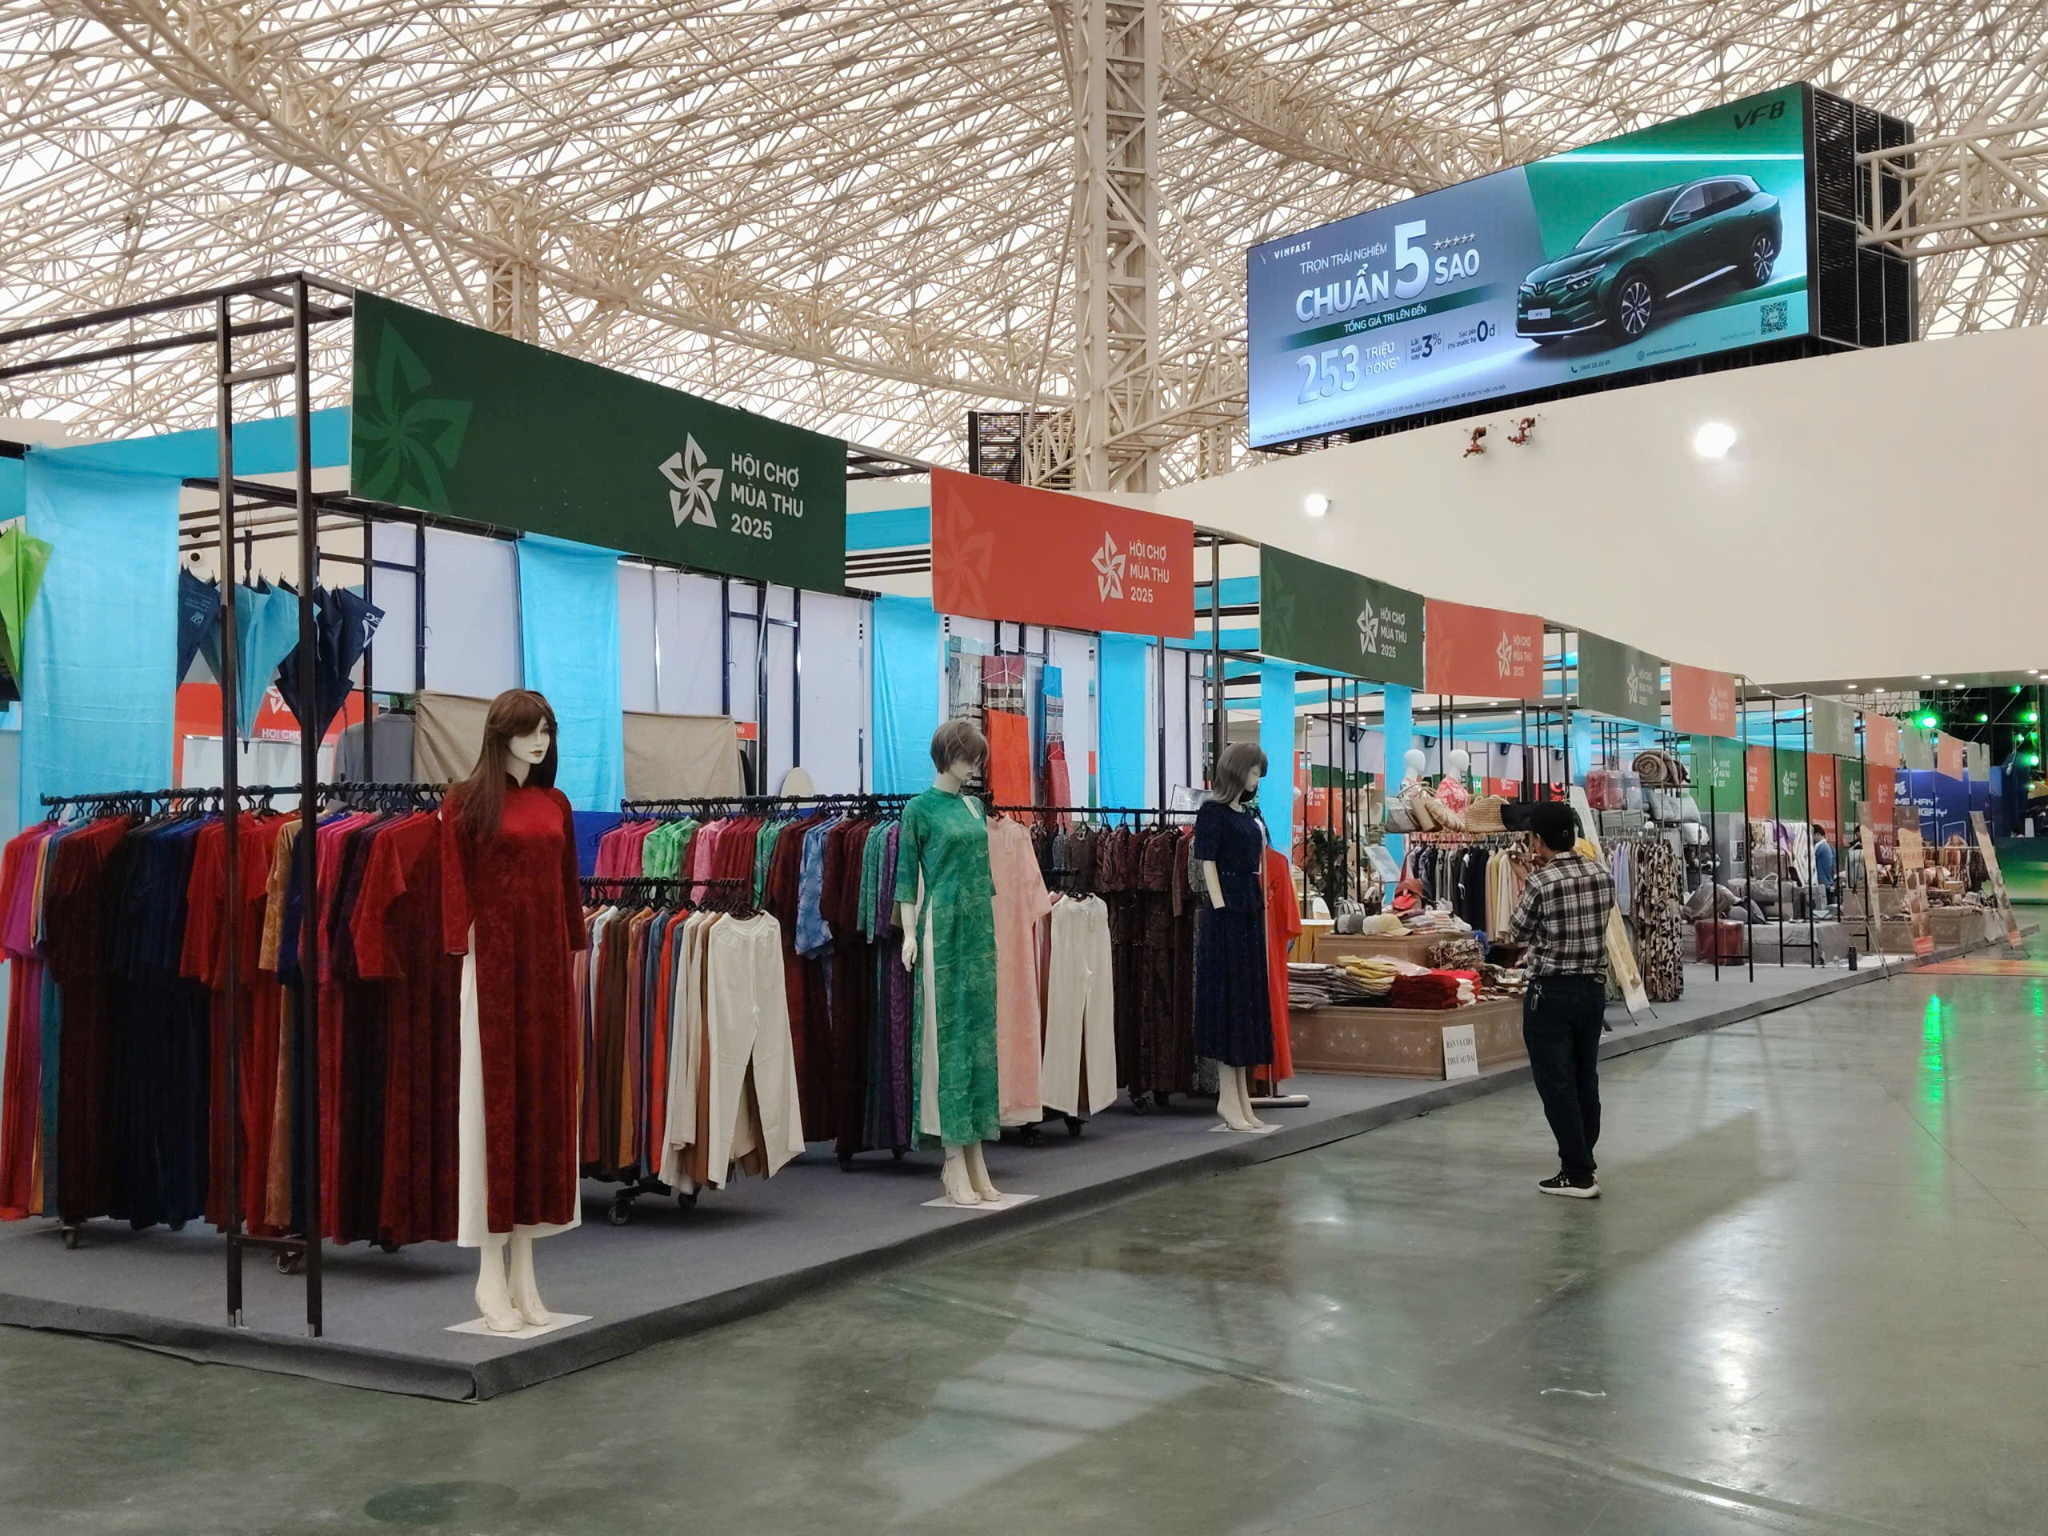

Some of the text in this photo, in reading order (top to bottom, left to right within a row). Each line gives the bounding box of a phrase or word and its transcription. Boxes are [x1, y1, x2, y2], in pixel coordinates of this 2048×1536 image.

[1733, 100, 1785, 129] VF8
[1274, 241, 1312, 260] VINFAST
[1299, 259, 1329, 275] TRỌN
[1354, 242, 1388, 262] NGHIỆM
[1296, 219, 1480, 322] CHUẨN 5 SAO
[1368, 314, 1382, 329] GIÁ
[1383, 311, 1395, 325] TRỊ
[1396, 308, 1411, 323] LÊN
[1411, 304, 1427, 319] ĐẾN
[1364, 341, 1395, 360] TRIỆU
[1296, 344, 1361, 405] 253
[731, 452, 800, 492] HỘI CHỢ
[731, 482, 804, 518] MÙA THU
[731, 513, 773, 541] 2025
[1129, 539, 1167, 564] HỘI CHỢ
[1130, 562, 1170, 584] MÙA THU
[1131, 586, 1154, 603] 2025
[1380, 607, 1406, 628] HỘI CHỢ
[1380, 624, 1408, 644] MÙA THU
[1380, 643, 1397, 658] 2025
